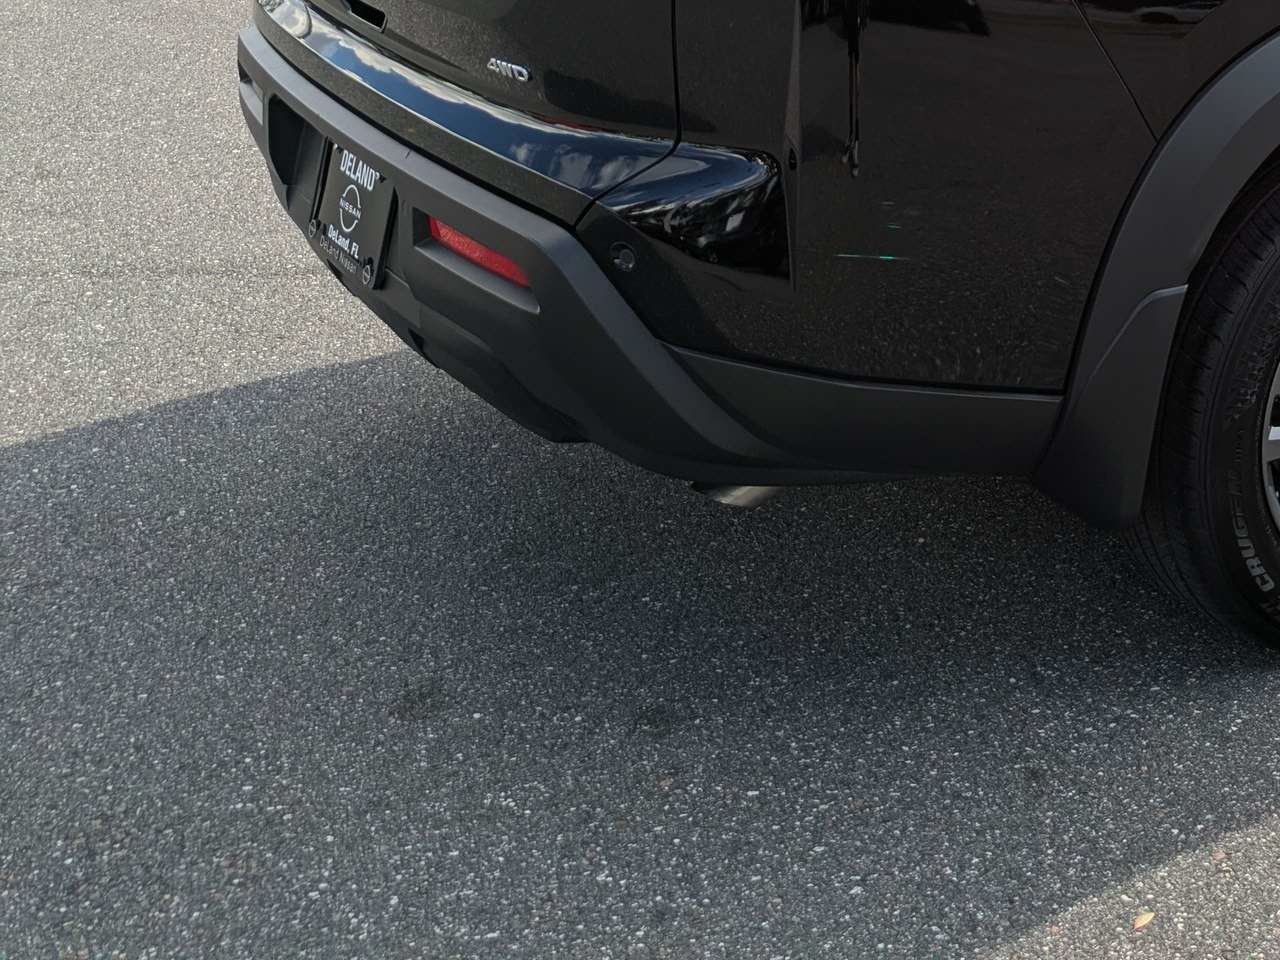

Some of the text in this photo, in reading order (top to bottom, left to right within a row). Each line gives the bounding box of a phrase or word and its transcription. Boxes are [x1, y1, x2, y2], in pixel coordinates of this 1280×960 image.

[487, 57, 529, 81] 4WD
[340, 150, 376, 191] DELAND
[340, 198, 361, 219] NISSAN
[350, 242, 359, 259] FL
